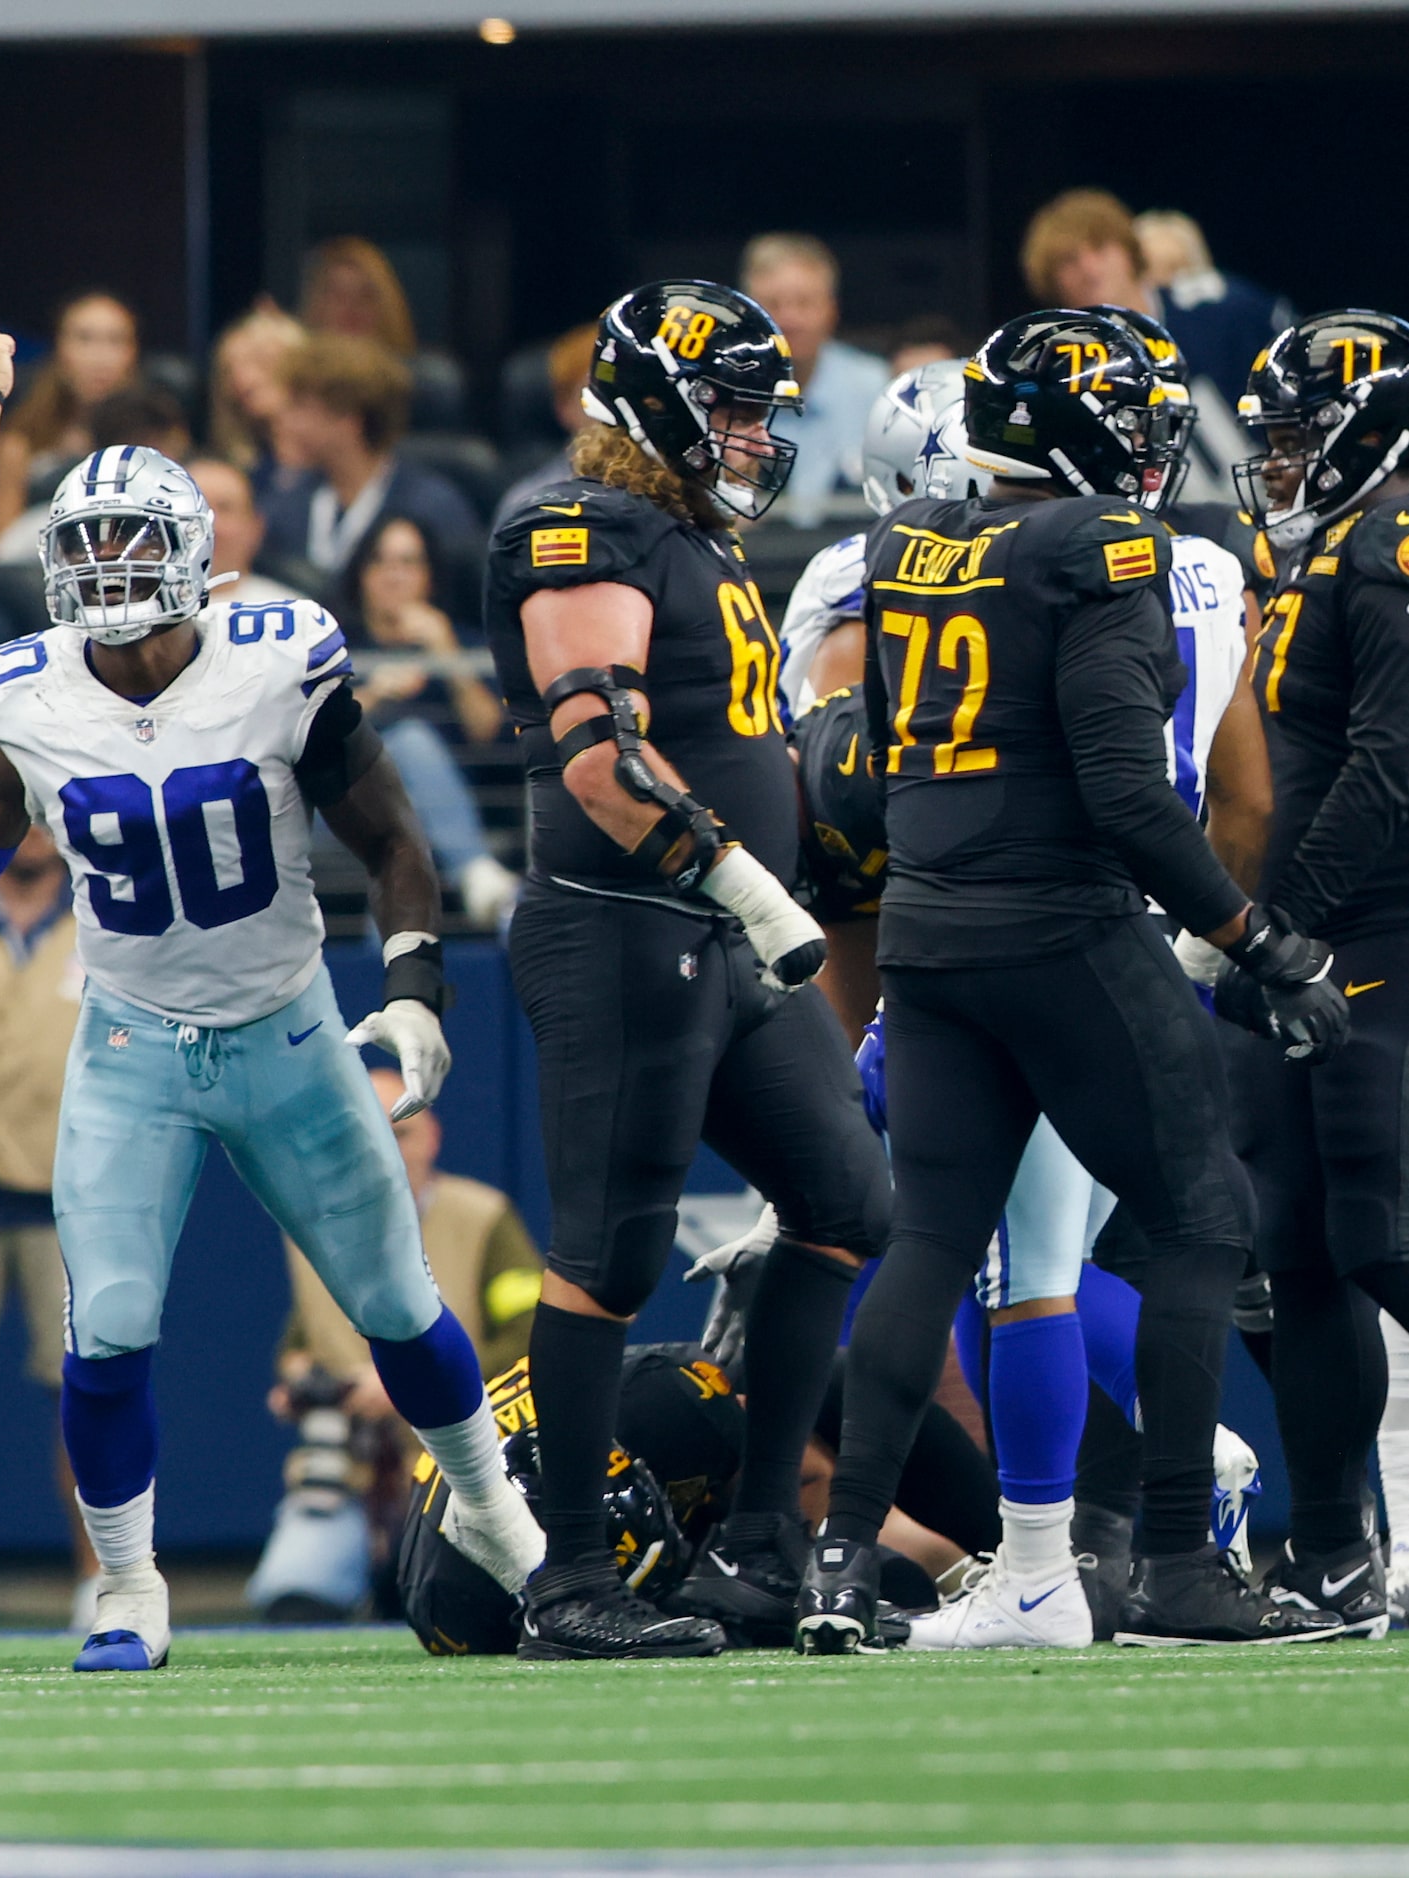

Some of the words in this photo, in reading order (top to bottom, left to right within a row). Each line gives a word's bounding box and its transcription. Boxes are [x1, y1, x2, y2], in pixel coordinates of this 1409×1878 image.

[657, 305, 718, 360] 68
[1055, 343, 1114, 393] 72
[1328, 336, 1383, 384] 77
[895, 538, 967, 584] LENO
[881, 609, 998, 777] 72
[57, 757, 280, 937] 90
